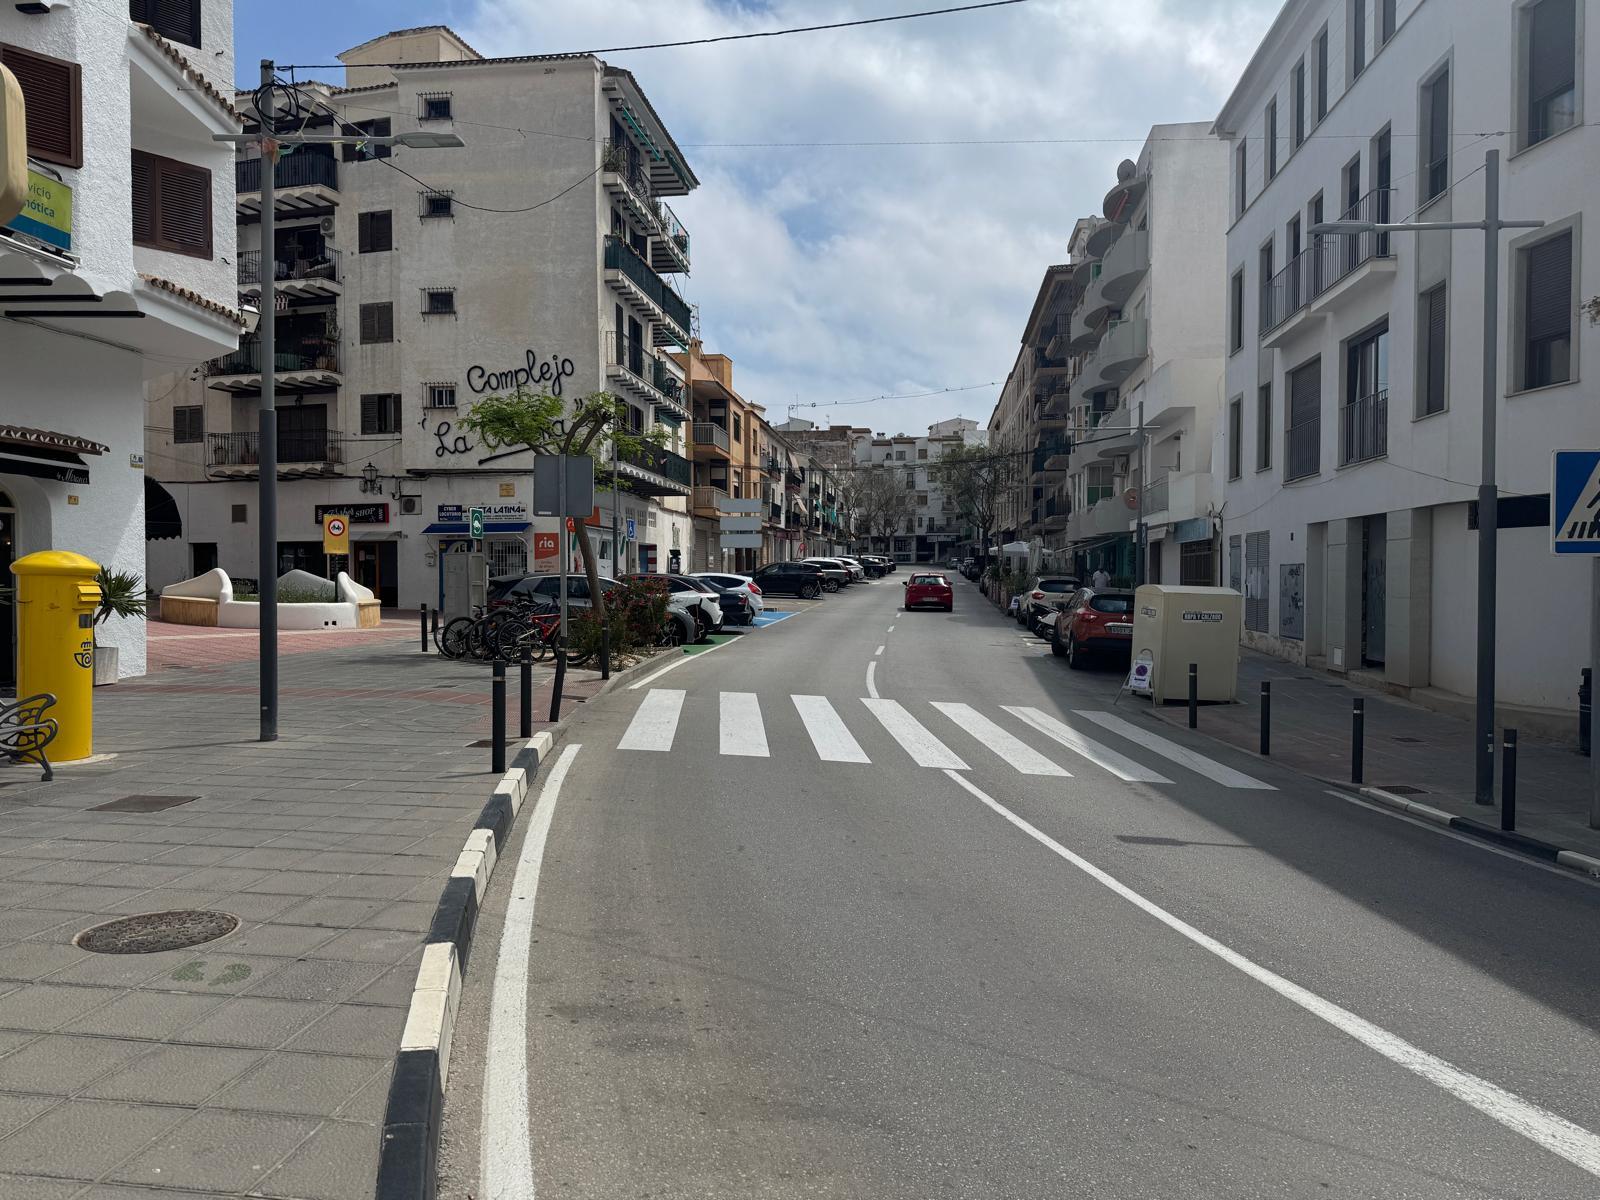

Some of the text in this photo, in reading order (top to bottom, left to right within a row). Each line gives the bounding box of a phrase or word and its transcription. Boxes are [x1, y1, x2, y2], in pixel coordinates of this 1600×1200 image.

[467, 349, 574, 400] Complejo
[355, 507, 376, 518] SHOP
[494, 506, 520, 514] LATINA
[539, 536, 554, 548] ria
